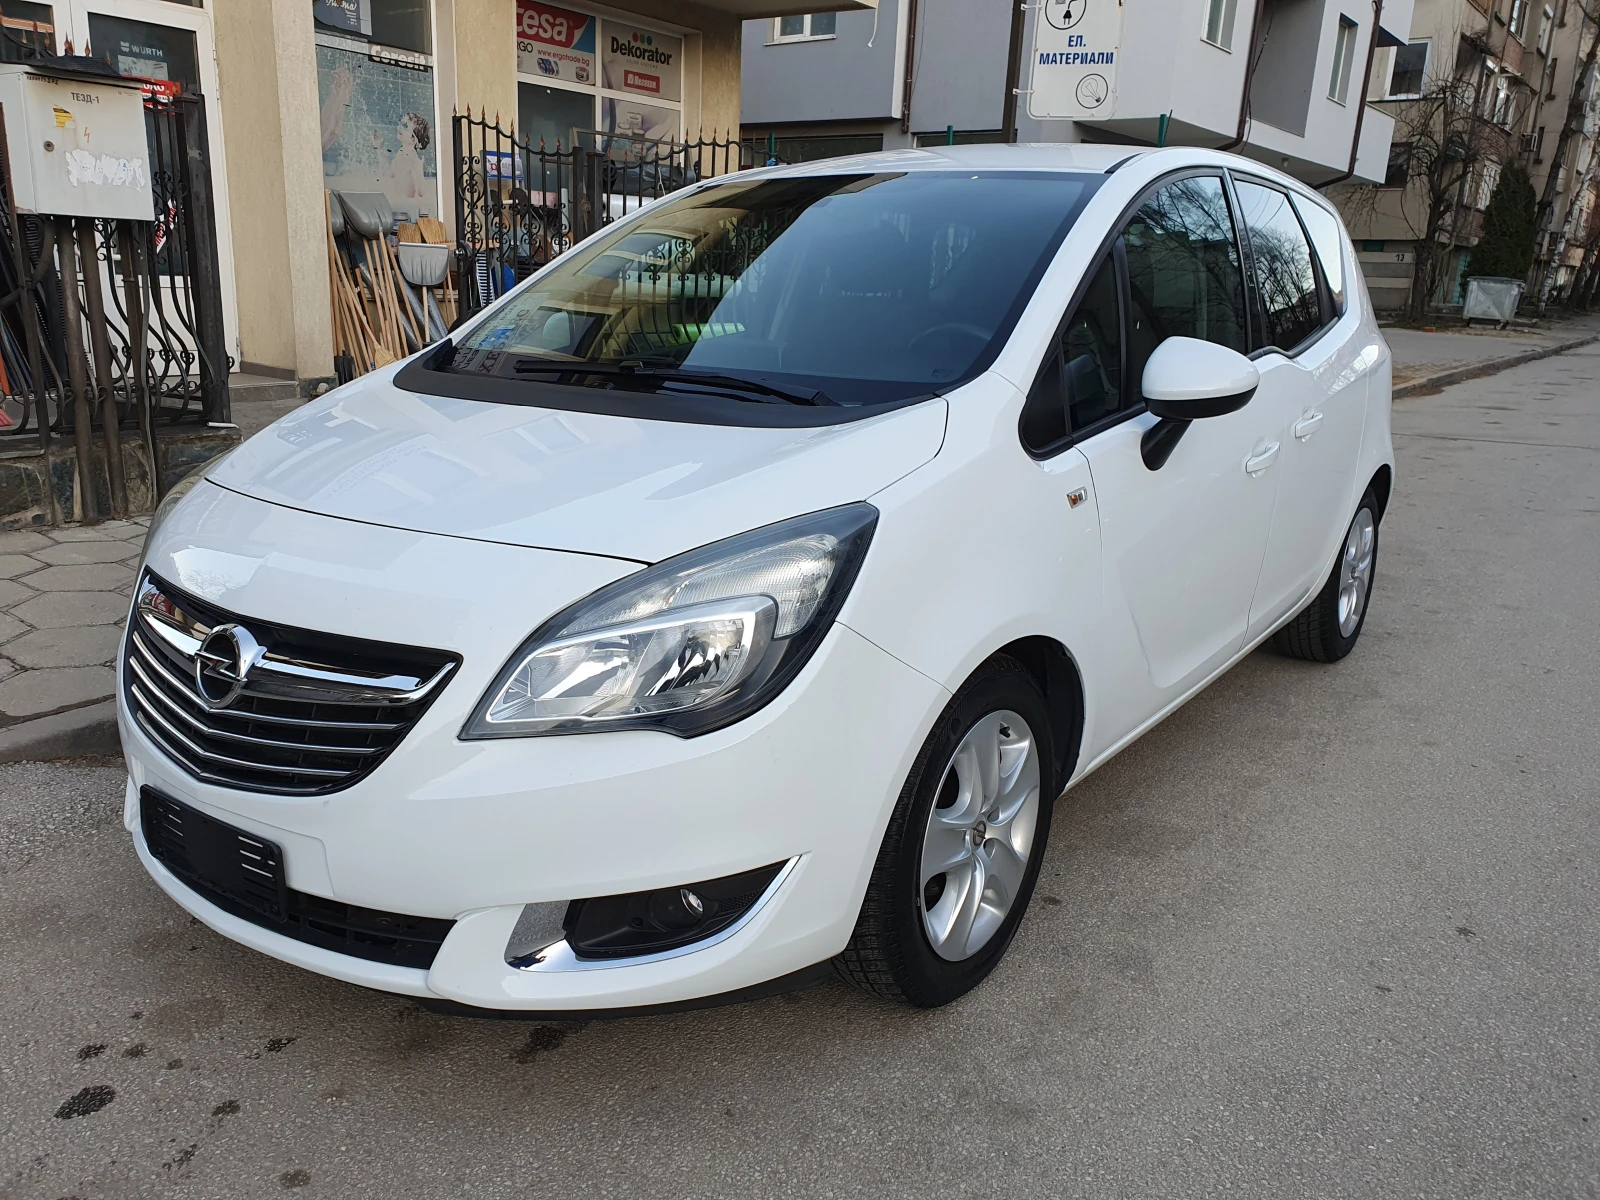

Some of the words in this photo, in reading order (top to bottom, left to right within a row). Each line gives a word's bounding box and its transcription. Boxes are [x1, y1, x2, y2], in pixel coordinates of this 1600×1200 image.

[517, 40, 534, 53] GO
[1067, 35, 1087, 48] ЕЛ.
[610, 36, 673, 66] Dekorator
[1039, 51, 1114, 65] МАТЕРИАЛИ
[70, 92, 100, 104] ТЕЗД-1
[1395, 253, 1405, 262] 13
